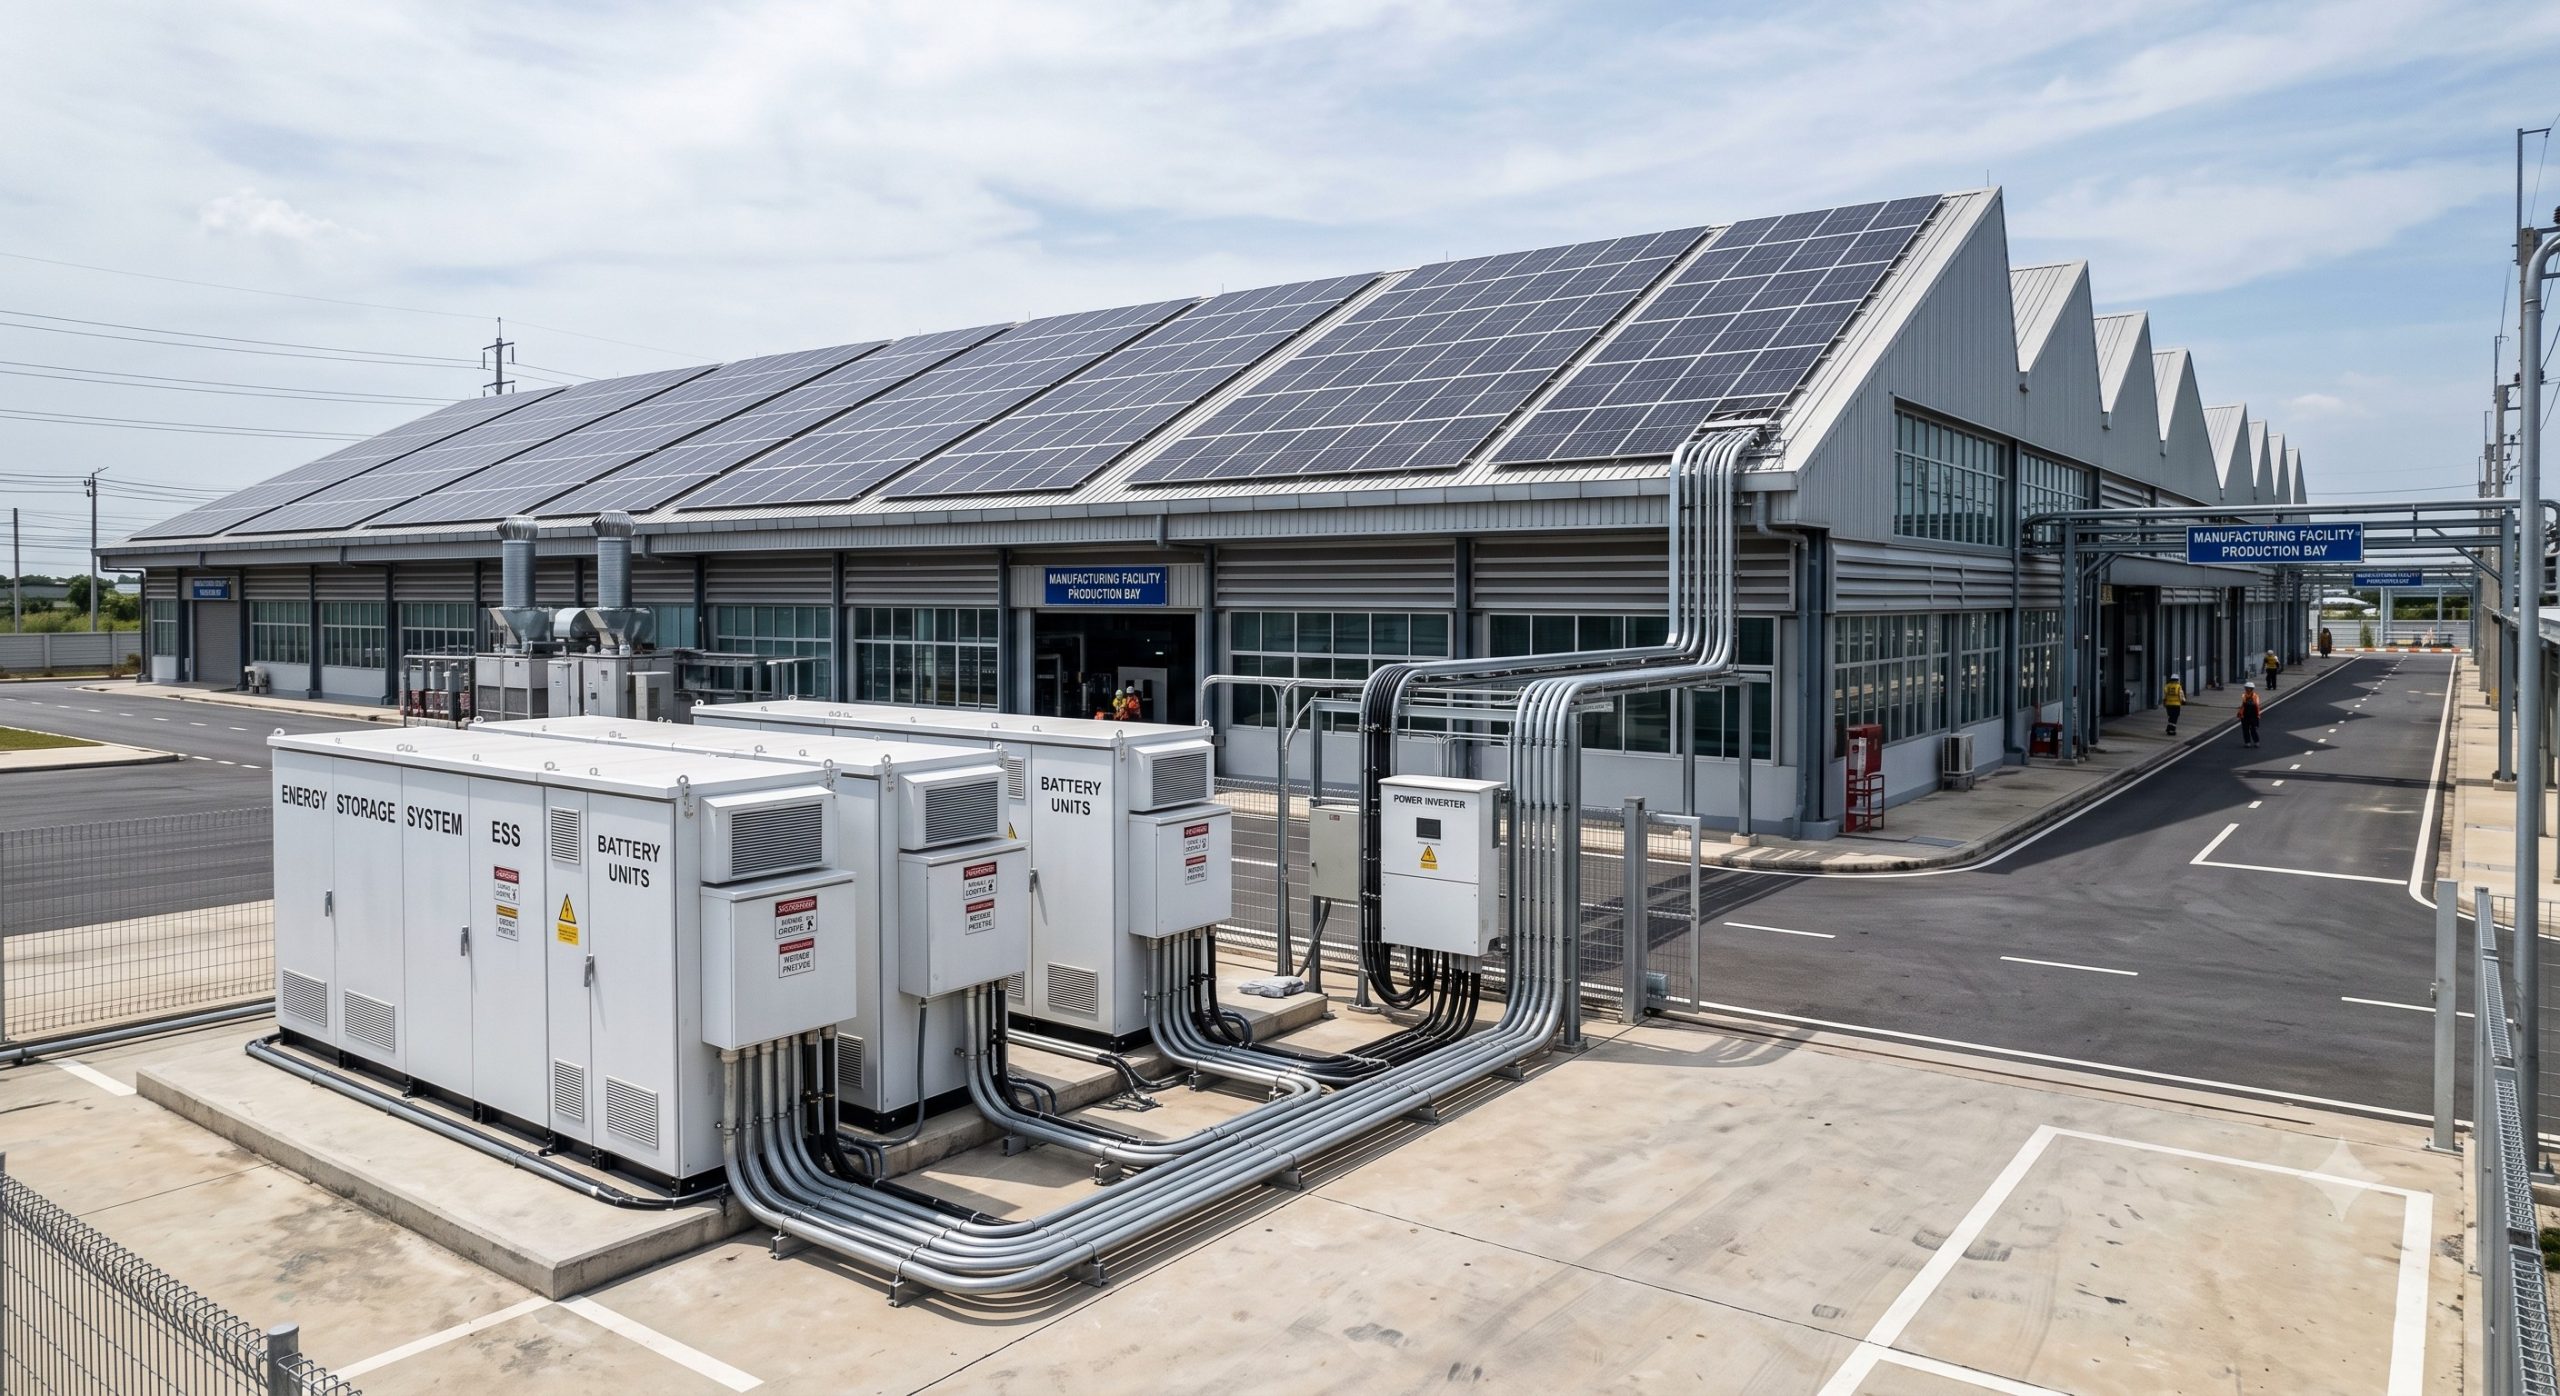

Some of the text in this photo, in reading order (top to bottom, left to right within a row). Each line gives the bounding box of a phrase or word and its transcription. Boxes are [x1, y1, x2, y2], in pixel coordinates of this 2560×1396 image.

[2194, 529, 2355, 543] MANUFACTURING FACILITY
[2222, 545, 2328, 557] PRODUCTION BAY
[1049, 573, 1160, 584] MANUFACTURING FACILITY
[1068, 588, 1141, 599] PRODUCTION BAY
[1041, 776, 1101, 796] BATTERY
[1051, 797, 1091, 816] UNITS
[1393, 794, 1466, 809] POWER INVERTER
[281, 784, 521, 848] ENERGY STORAGE SYSTEM ESS
[597, 834, 661, 863] BATTERY
[608, 862, 650, 888] UNITS
